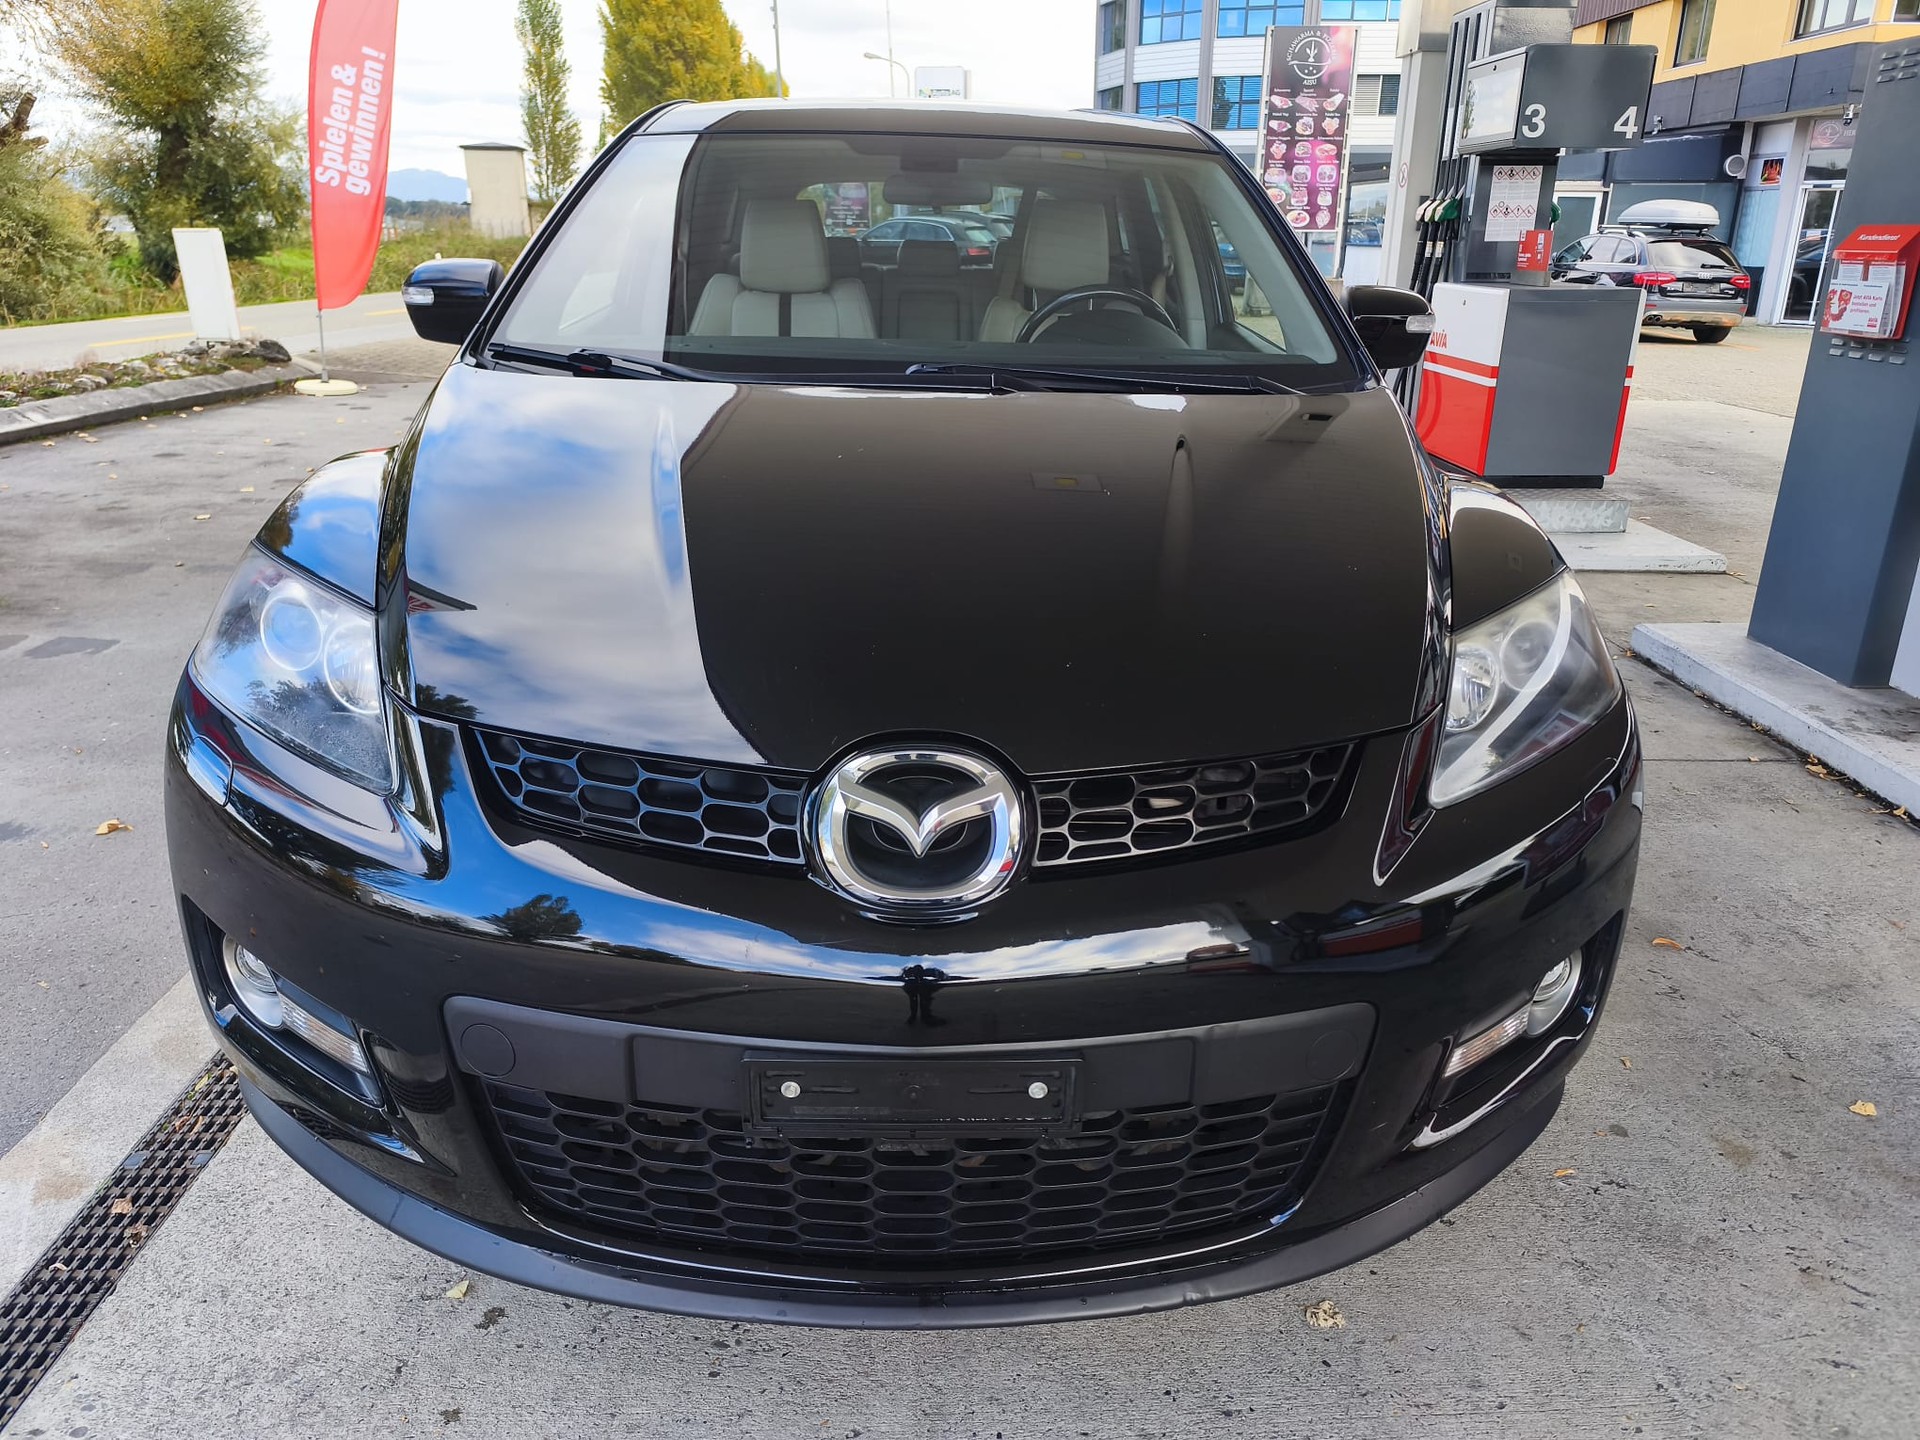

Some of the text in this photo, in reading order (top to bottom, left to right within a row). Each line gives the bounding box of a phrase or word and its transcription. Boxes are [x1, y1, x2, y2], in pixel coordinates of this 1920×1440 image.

[314, 63, 358, 187] Spielen &
[345, 46, 387, 196] gewinnen!
[1522, 103, 1546, 138] 3
[1613, 106, 1638, 139] 4
[1430, 330, 1447, 349] AVIA
